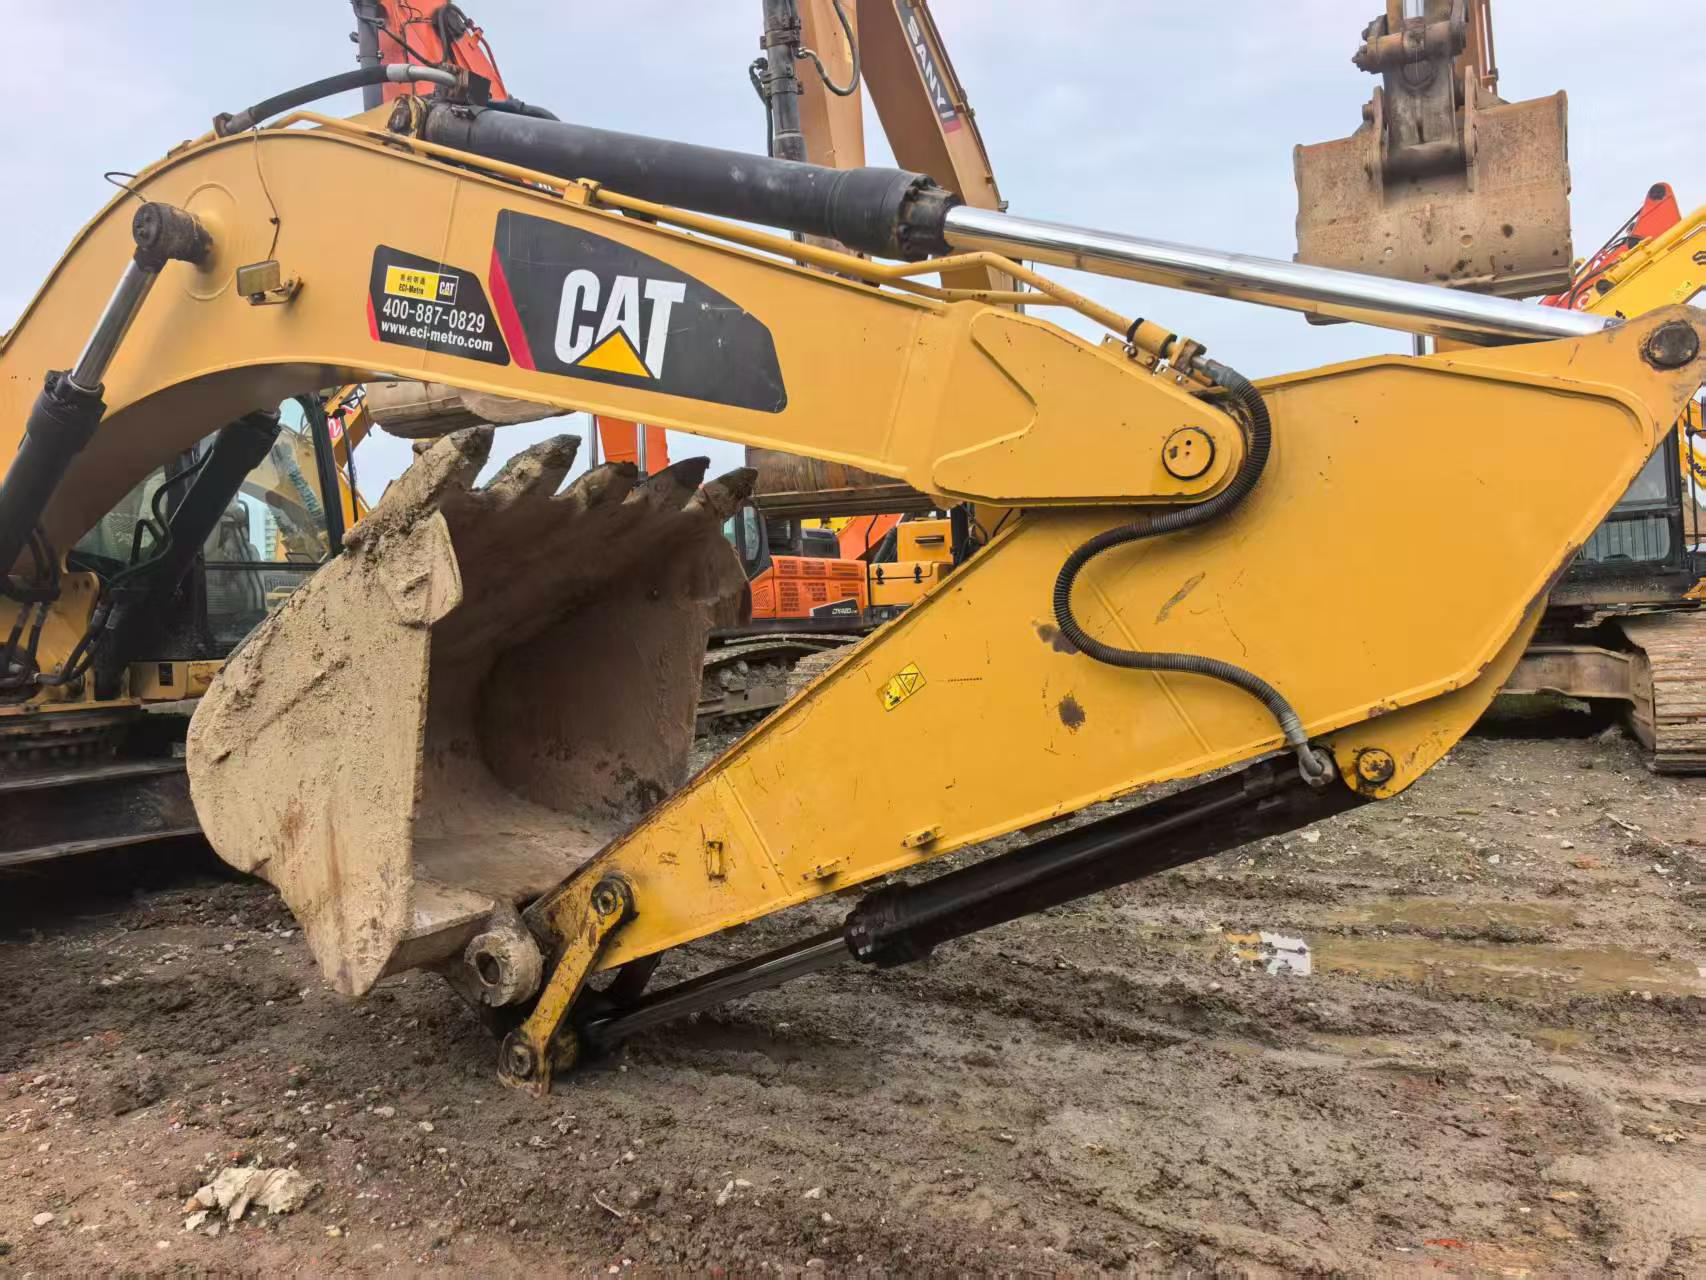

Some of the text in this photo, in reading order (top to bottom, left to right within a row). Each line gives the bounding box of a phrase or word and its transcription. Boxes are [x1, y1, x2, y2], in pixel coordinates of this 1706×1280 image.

[907, 15, 947, 109] SANY
[439, 281, 455, 297] CAT
[382, 297, 486, 334] 400-887-0829
[554, 269, 686, 380] CAT
[381, 320, 493, 352] www.eci-metro.com
